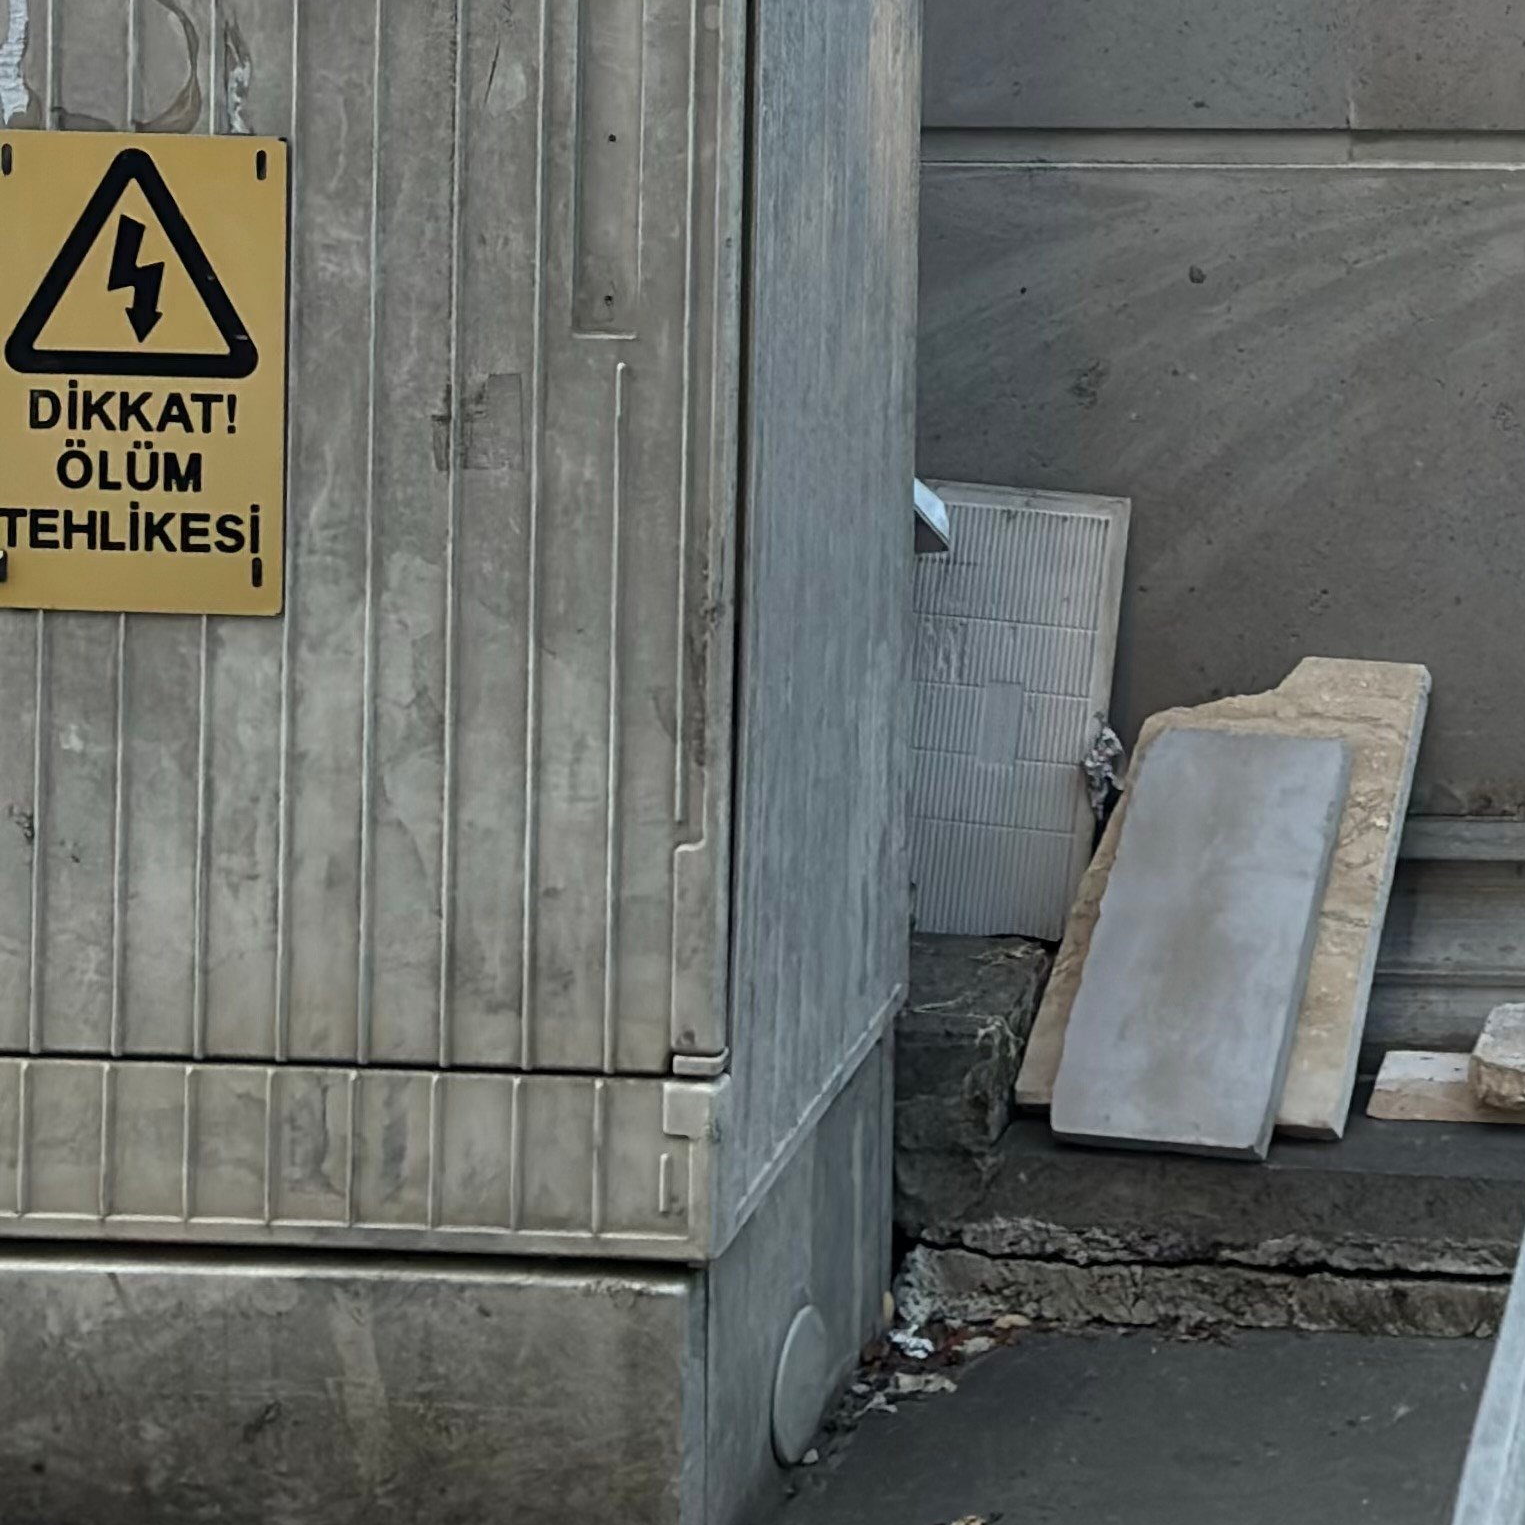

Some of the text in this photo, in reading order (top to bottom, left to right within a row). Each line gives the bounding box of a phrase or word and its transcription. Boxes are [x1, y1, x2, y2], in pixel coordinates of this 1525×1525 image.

[29, 379, 237, 434] DİKKAT!
[56, 438, 203, 493] ÖLÜM
[0, 501, 260, 554] TEHLİKESİ
